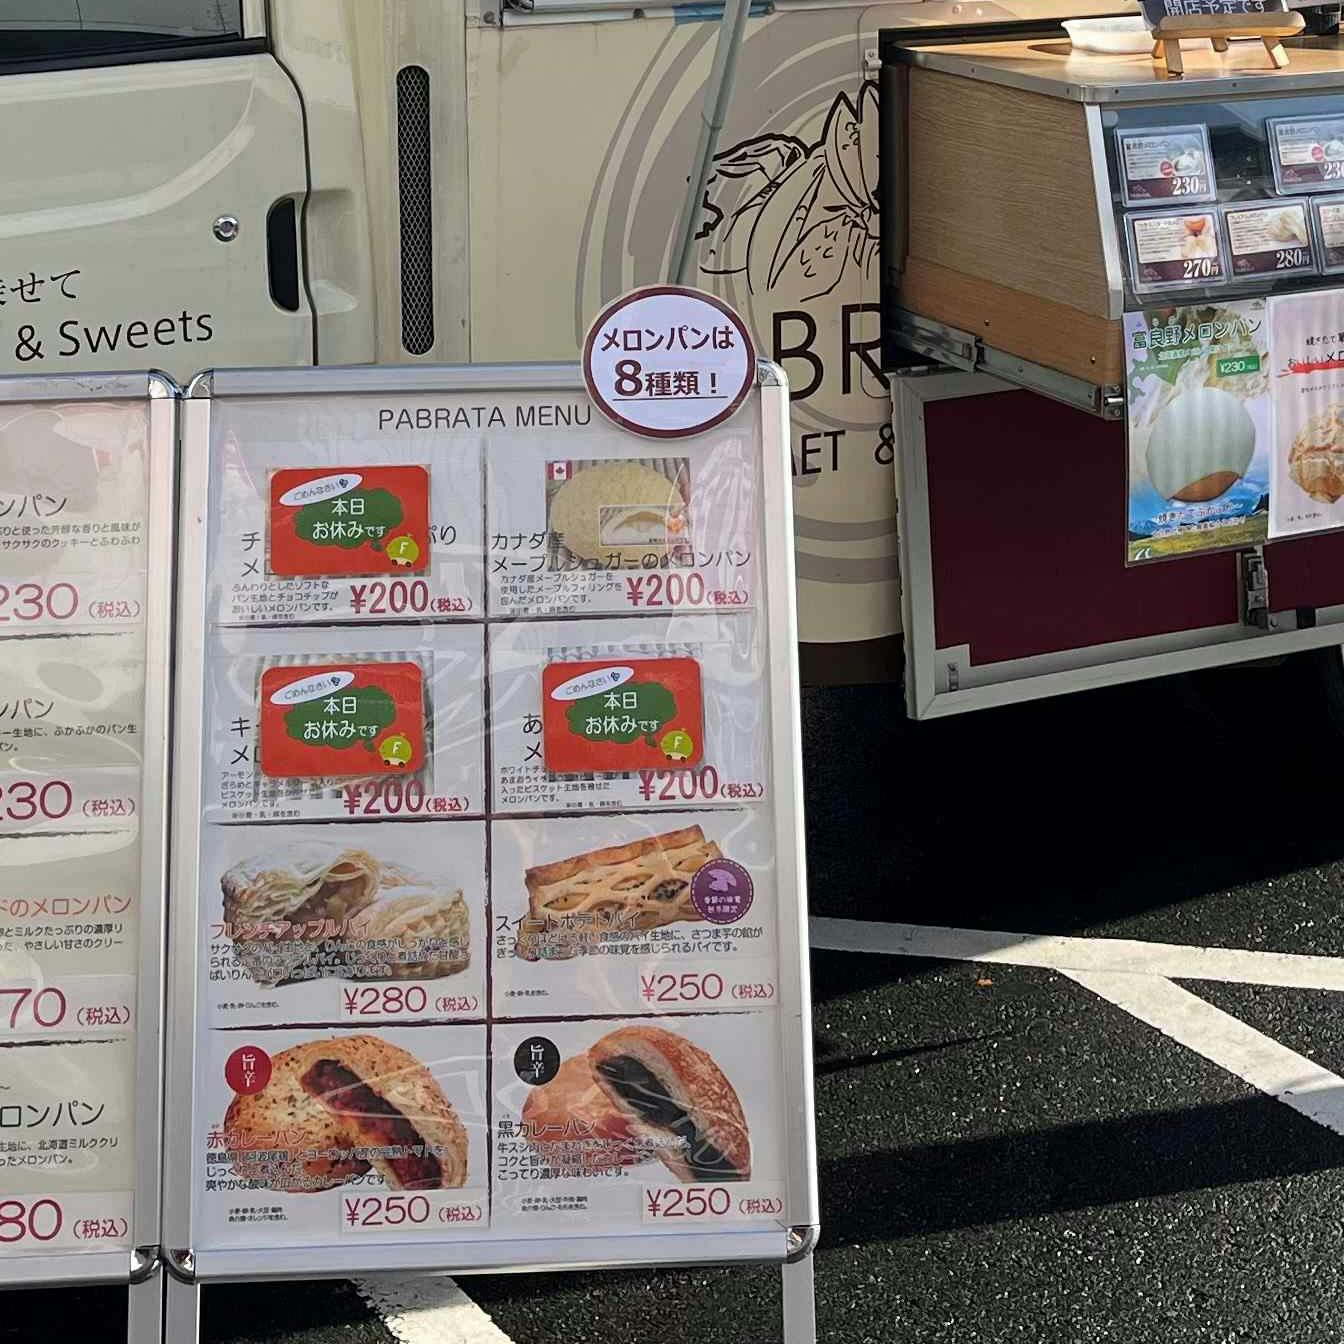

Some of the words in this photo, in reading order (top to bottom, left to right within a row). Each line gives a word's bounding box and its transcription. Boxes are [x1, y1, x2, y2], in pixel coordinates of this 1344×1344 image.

[14, 322, 44, 360] &
[58, 308, 214, 358] Sweets
[601, 325, 736, 353] メロンパンは
[378, 405, 507, 432] PABRATA
[515, 403, 592, 427] MENU
[791, 428, 847, 478] ET
[331, 498, 366, 517] 本日
[311, 521, 387, 540] お休みです
[350, 580, 431, 615] ¥200
[625, 572, 706, 607] ¥200
[323, 696, 358, 716] 本日
[603, 691, 638, 711] 本日
[303, 720, 378, 740] お休みです
[585, 715, 660, 736] お休みです
[638, 764, 719, 801] ¥200
[343, 779, 426, 816] ¥200
[495, 911, 641, 932] スイートポテトパイ
[343, 985, 428, 1016] ¥280
[640, 973, 724, 1003] ¥250
[206, 1128, 307, 1149] 赤カレーパン
[497, 1119, 598, 1140] 黒カレーパン
[344, 1195, 431, 1226] ¥250
[646, 1187, 731, 1218] ¥250
